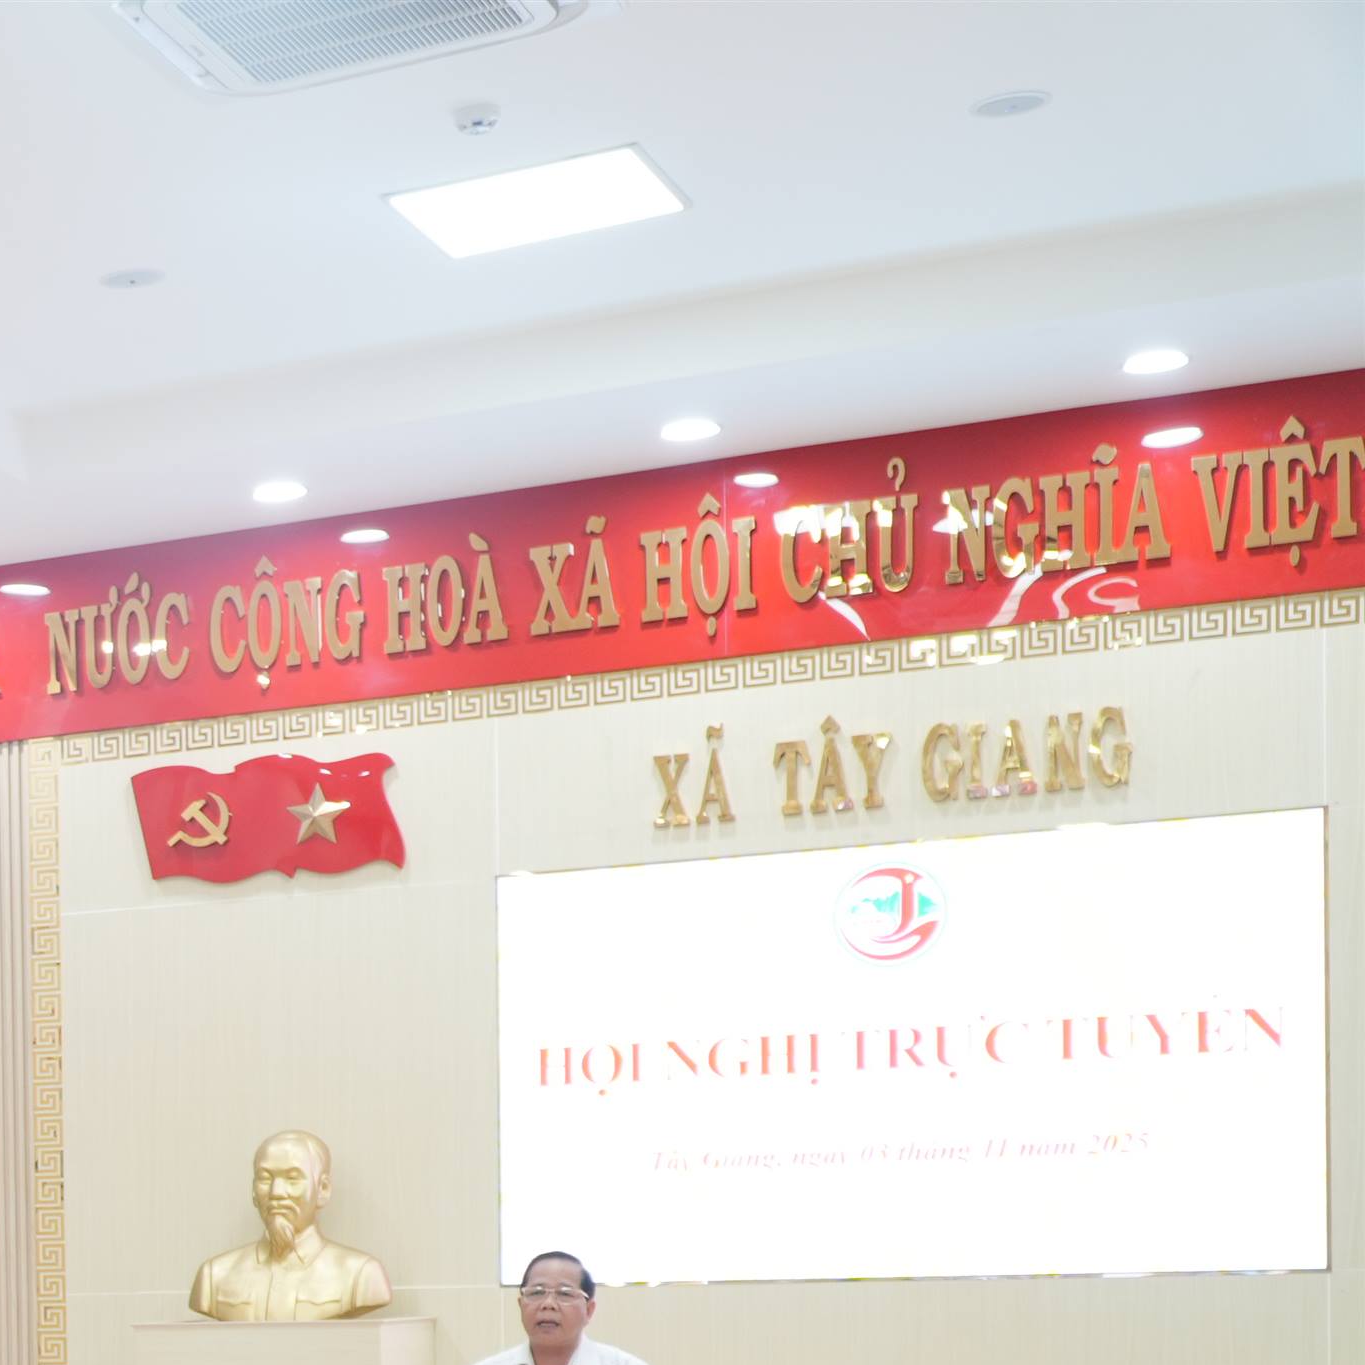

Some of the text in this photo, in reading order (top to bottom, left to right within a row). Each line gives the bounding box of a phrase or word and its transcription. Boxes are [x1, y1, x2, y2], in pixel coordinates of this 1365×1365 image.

[45, 414, 1365, 695] NƯỚC CỘNG HOÀ XÃ HỘI CHỦ NGHĨA VIỆT
[652, 706, 1134, 829] XÃ TÂY GIANG
